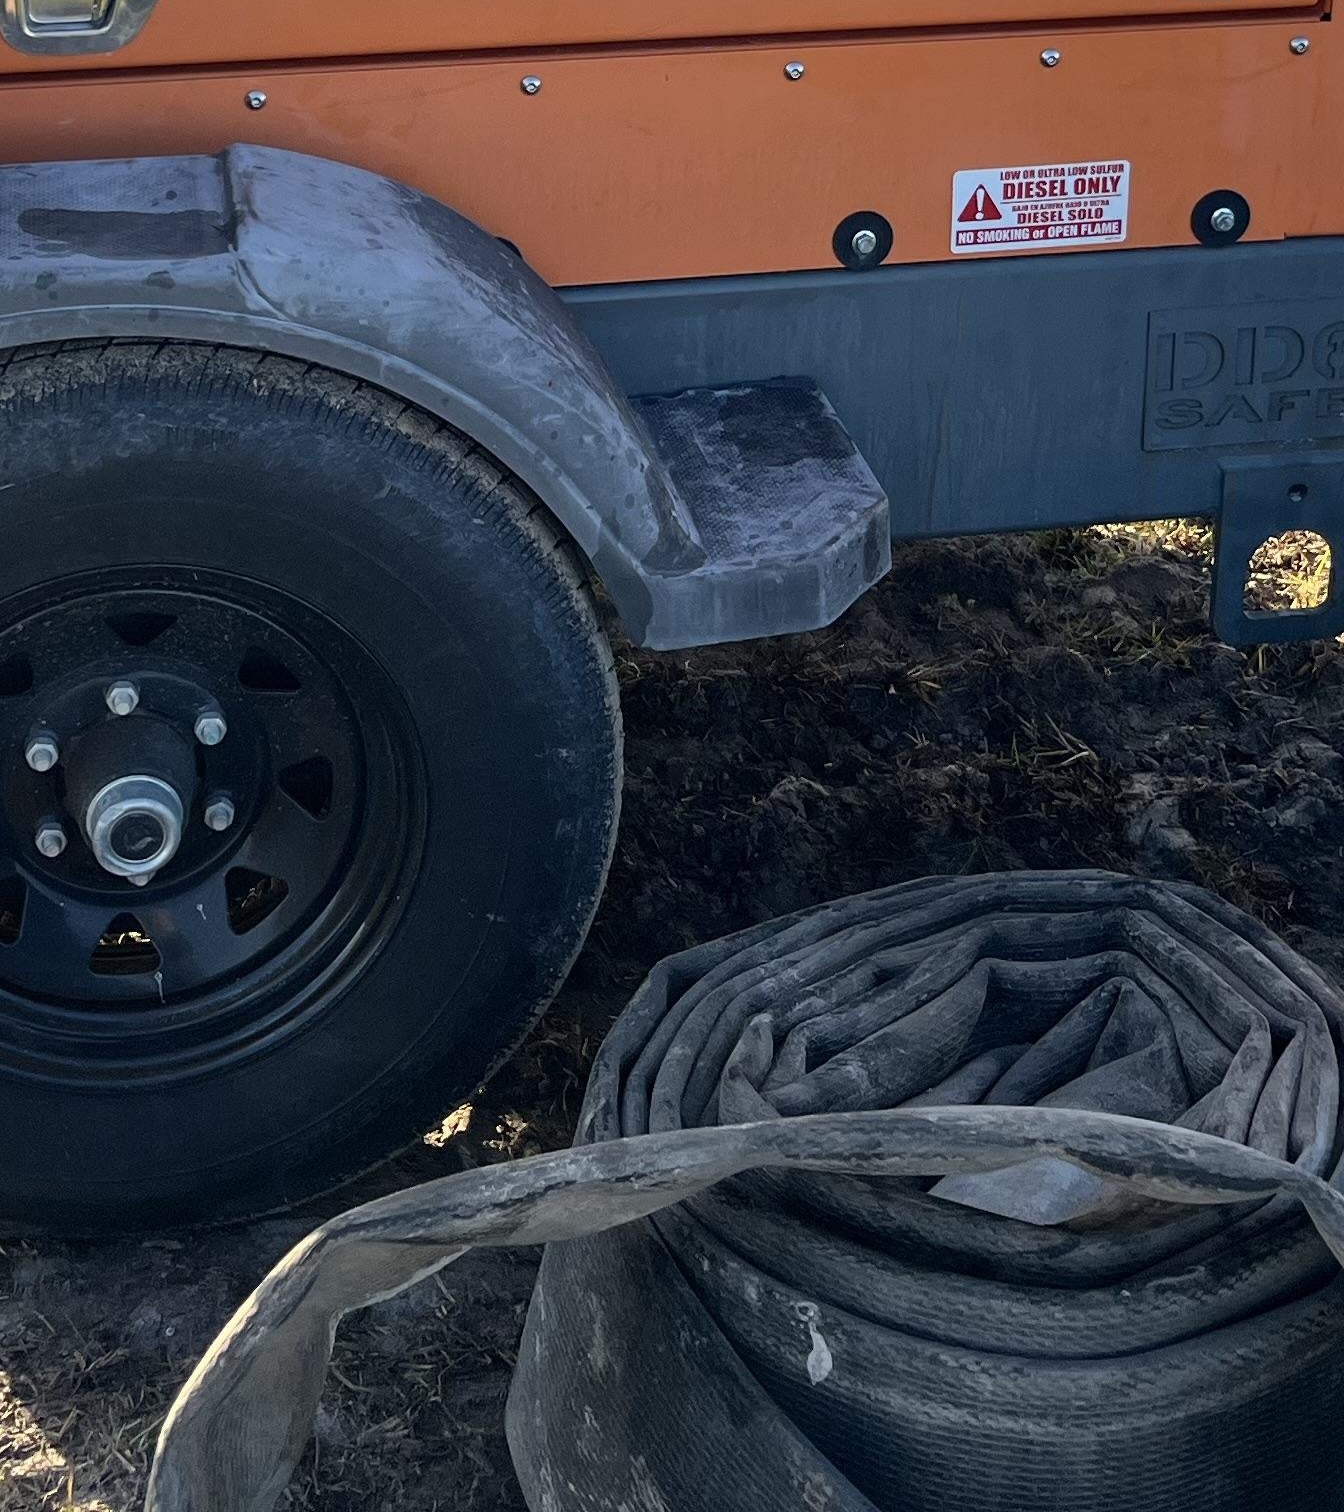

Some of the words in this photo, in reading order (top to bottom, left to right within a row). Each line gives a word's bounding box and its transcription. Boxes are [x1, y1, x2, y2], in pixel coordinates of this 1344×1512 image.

[1000, 170, 1019, 181] LOW
[1023, 169, 1036, 179] OR
[1038, 167, 1065, 178] ULTRA
[1068, 166, 1088, 176] LOW
[1090, 164, 1124, 175] SULFUR
[1003, 179, 1068, 200] DIESEL
[1074, 176, 1121, 195] ONLY
[1017, 210, 1064, 224] DIESEL
[1068, 208, 1104, 220] SOLO
[958, 232, 974, 245] NO
[977, 229, 1029, 243] SMOKING
[1032, 229, 1044, 239] or
[1048, 225, 1078, 237] OPEN
[1081, 222, 1119, 235] FLAME
